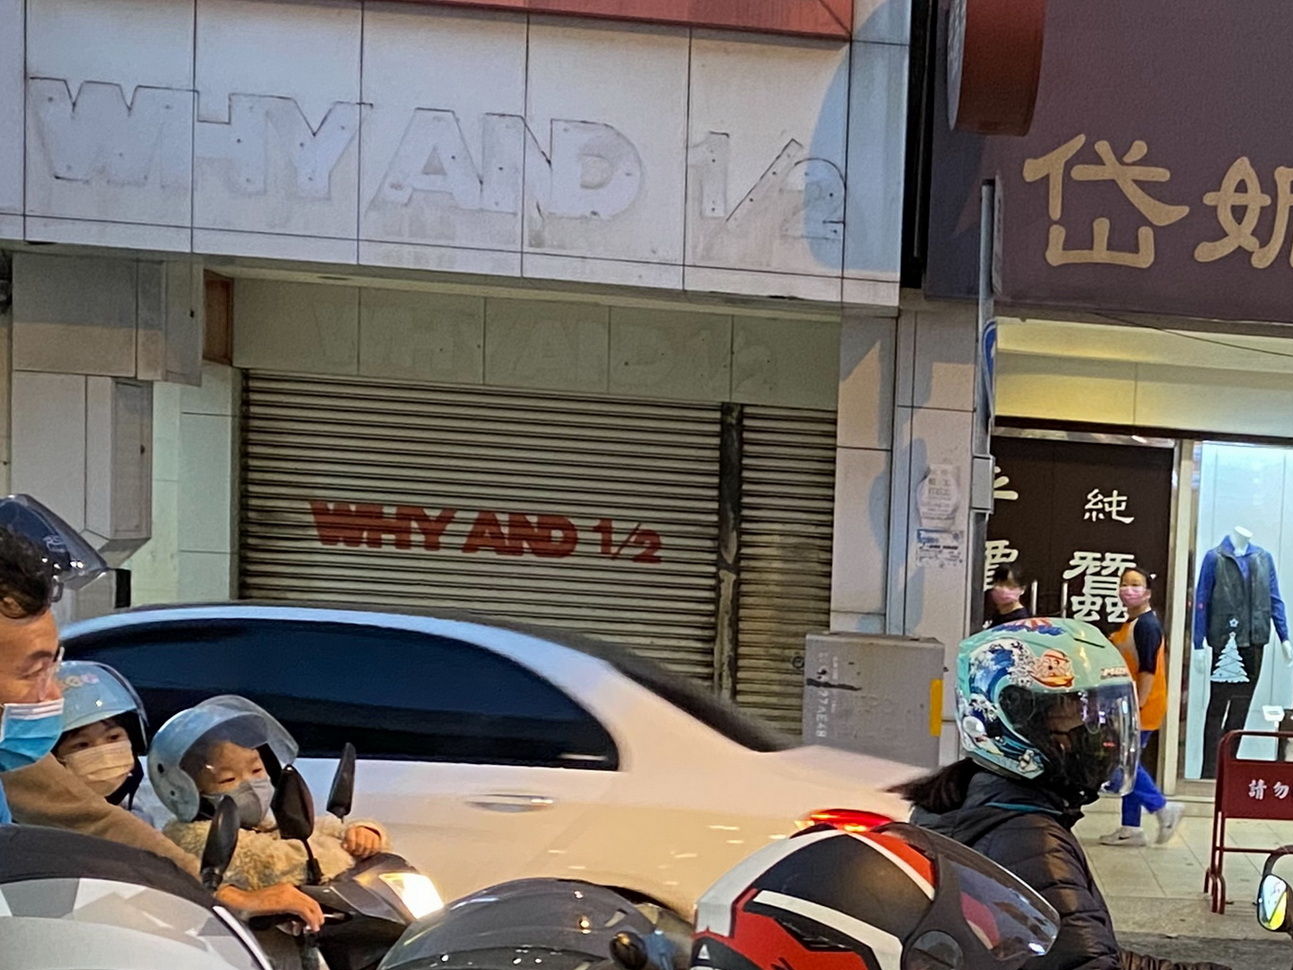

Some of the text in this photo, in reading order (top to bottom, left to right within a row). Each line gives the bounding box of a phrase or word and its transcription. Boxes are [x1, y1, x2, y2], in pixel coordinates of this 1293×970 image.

[28, 77, 373, 199] WHY
[366, 106, 645, 219] AND
[309, 500, 457, 550] WHY
[461, 510, 579, 558] AND
[1248, 779, 1289, 800] 請勿
